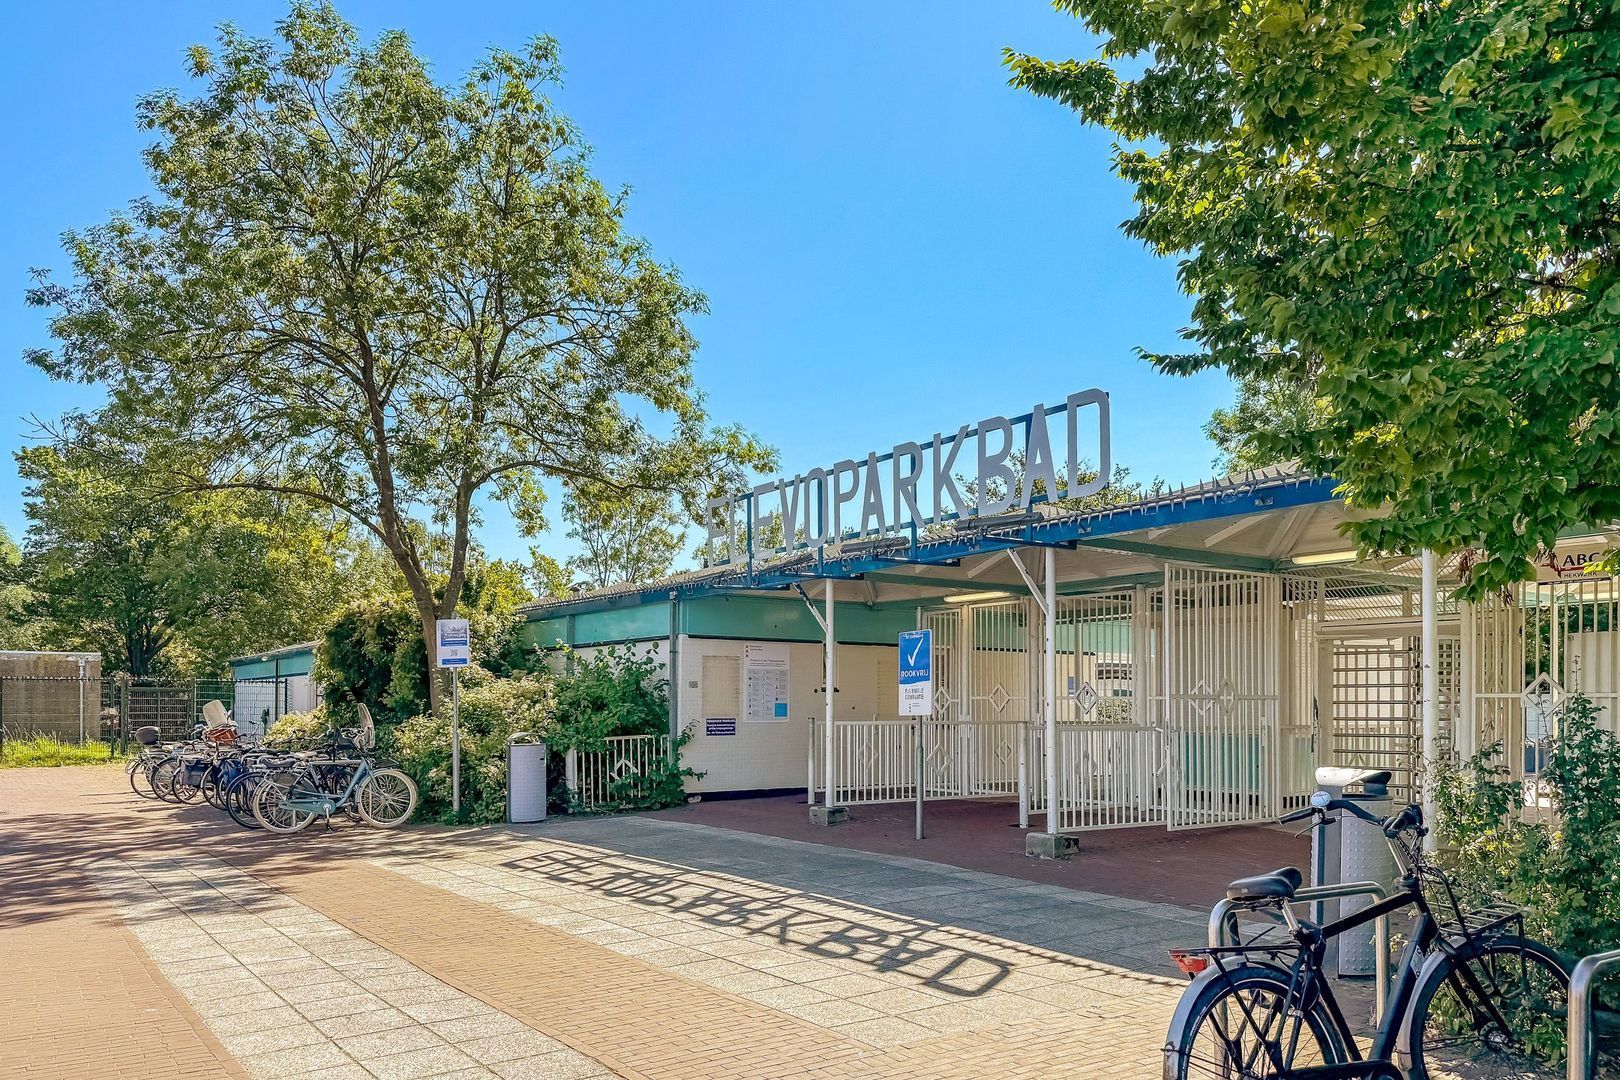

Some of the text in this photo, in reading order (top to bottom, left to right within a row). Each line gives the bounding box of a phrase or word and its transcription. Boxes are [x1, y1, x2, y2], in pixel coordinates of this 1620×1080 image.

[707, 388, 1111, 567] FLEVOPARKBAD
[1562, 552, 1600, 567] ABC
[900, 669, 929, 678] ROOKVRIJ
